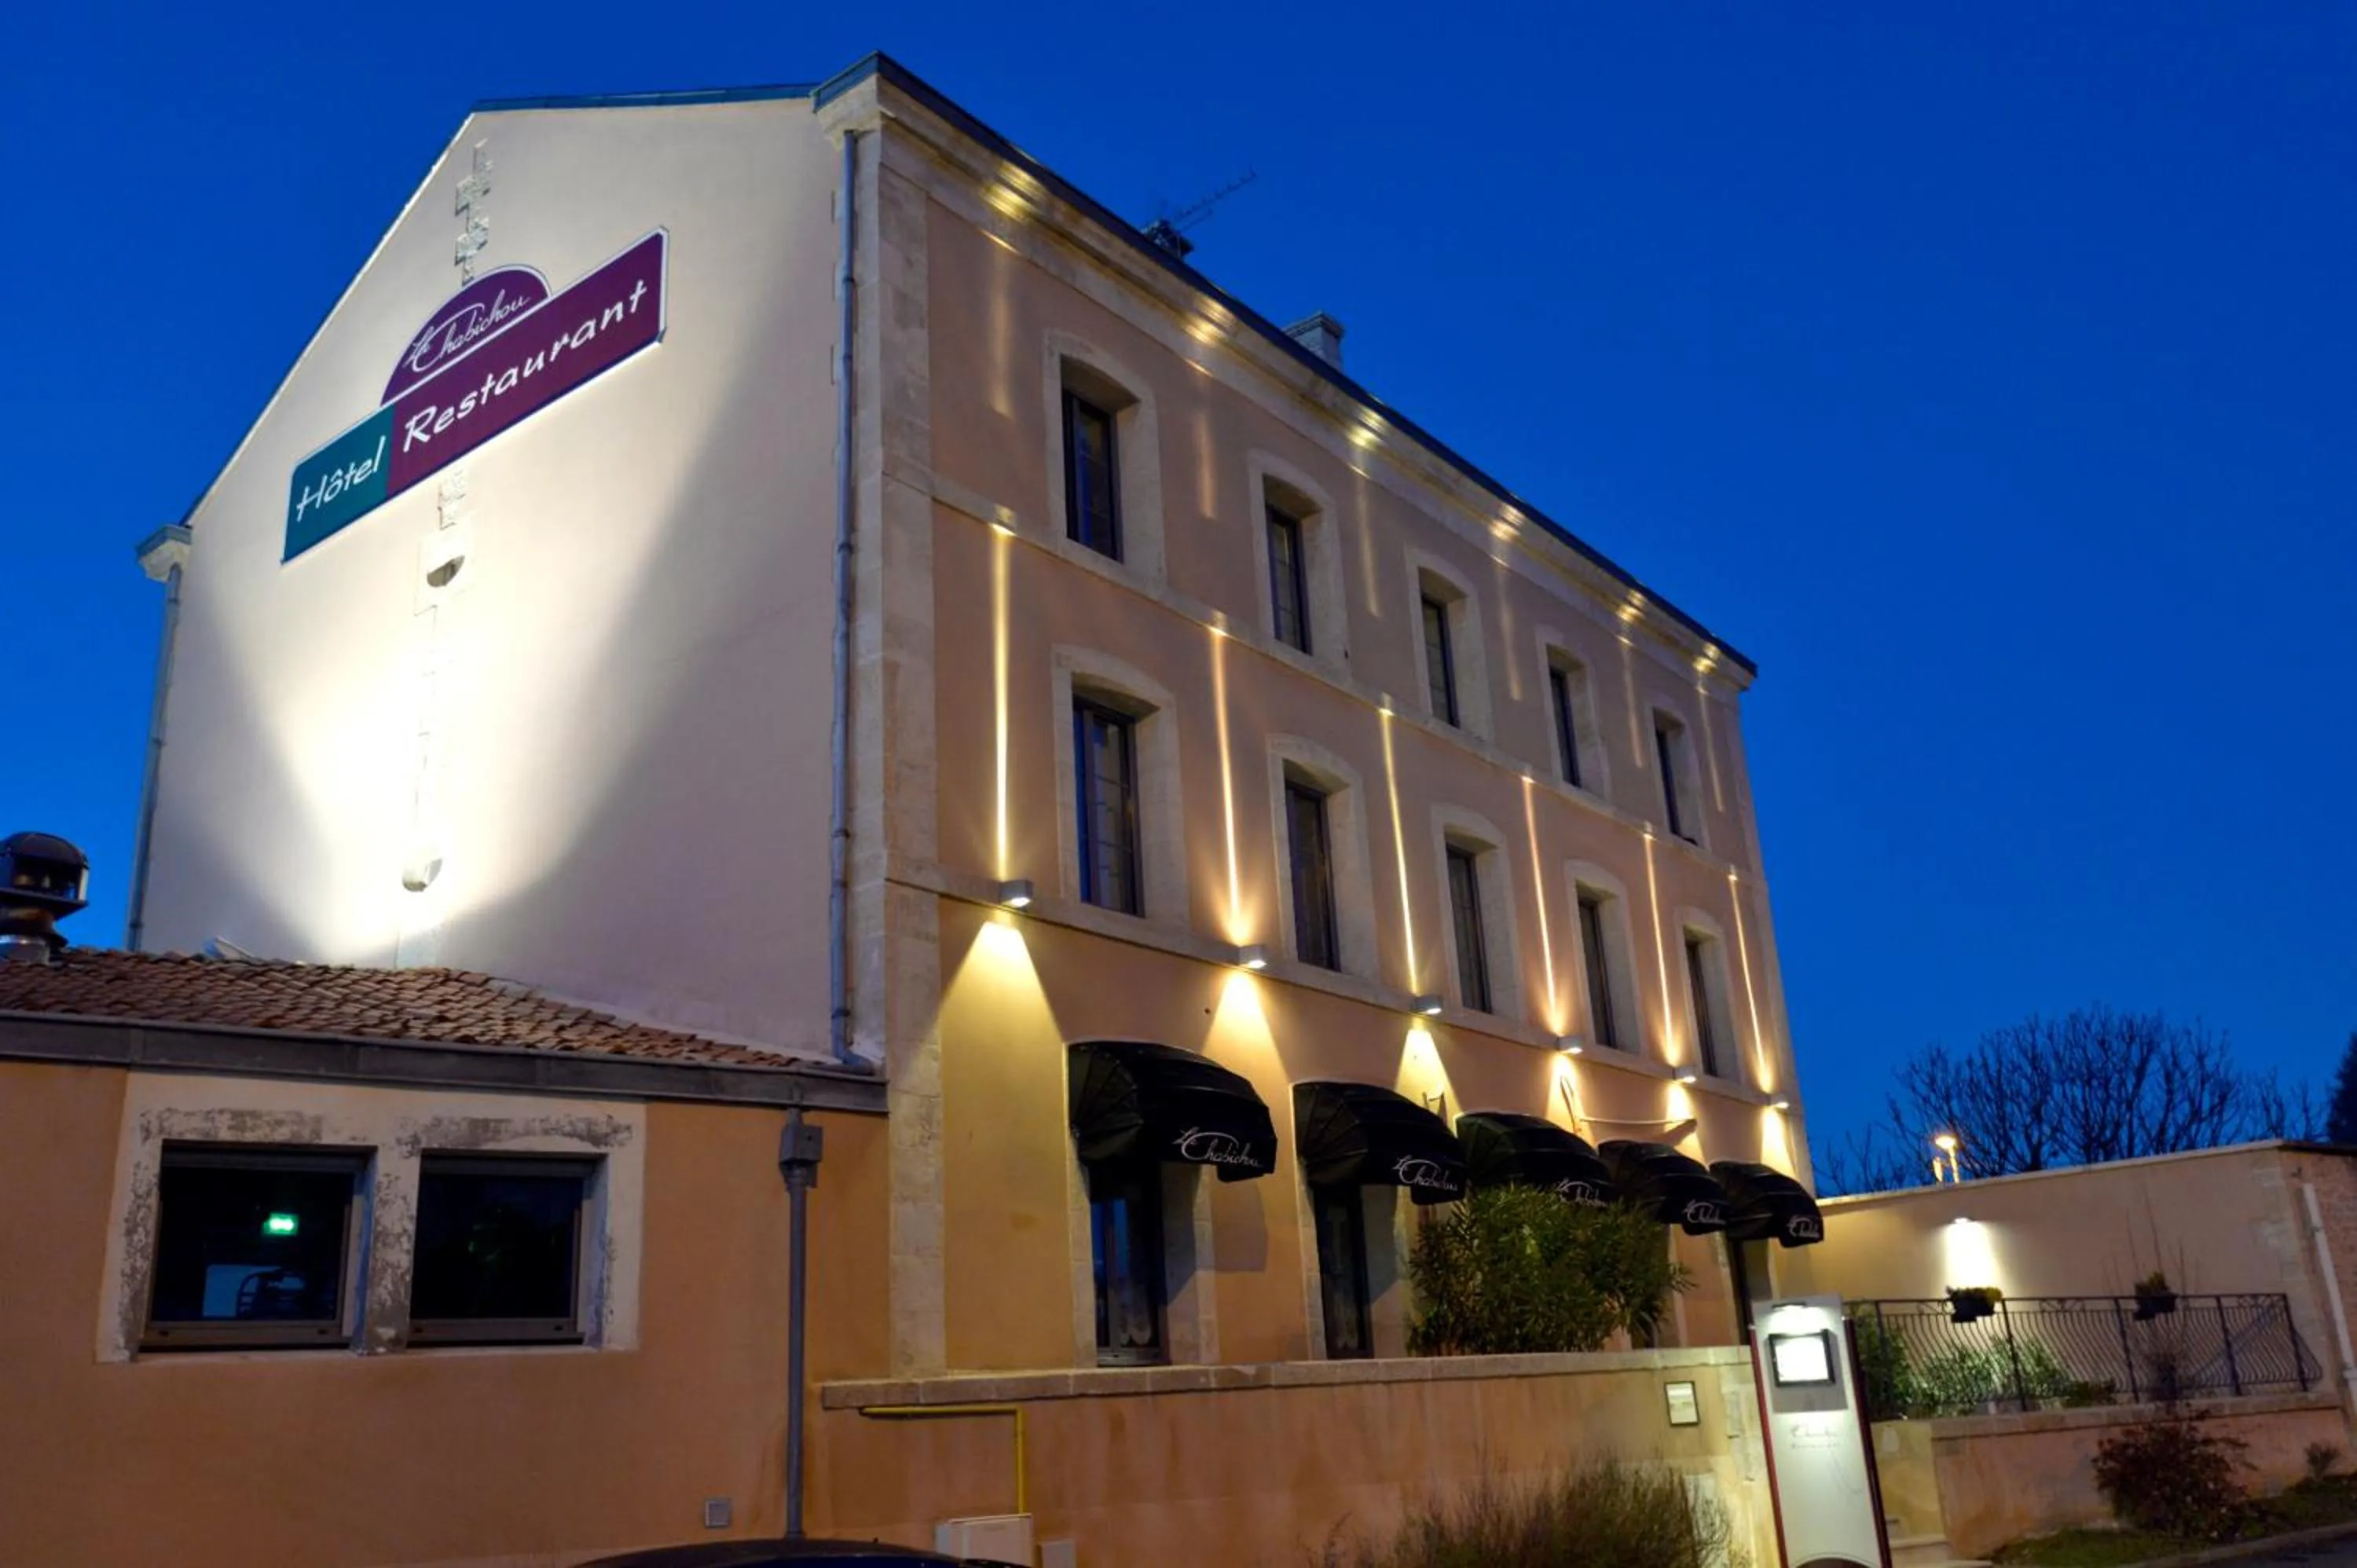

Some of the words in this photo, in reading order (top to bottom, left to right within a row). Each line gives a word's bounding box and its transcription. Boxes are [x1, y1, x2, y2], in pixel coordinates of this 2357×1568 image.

[296, 434, 387, 523] Hôtel
[402, 280, 647, 452] Restaurant
[412, 288, 532, 372] Chabichou
